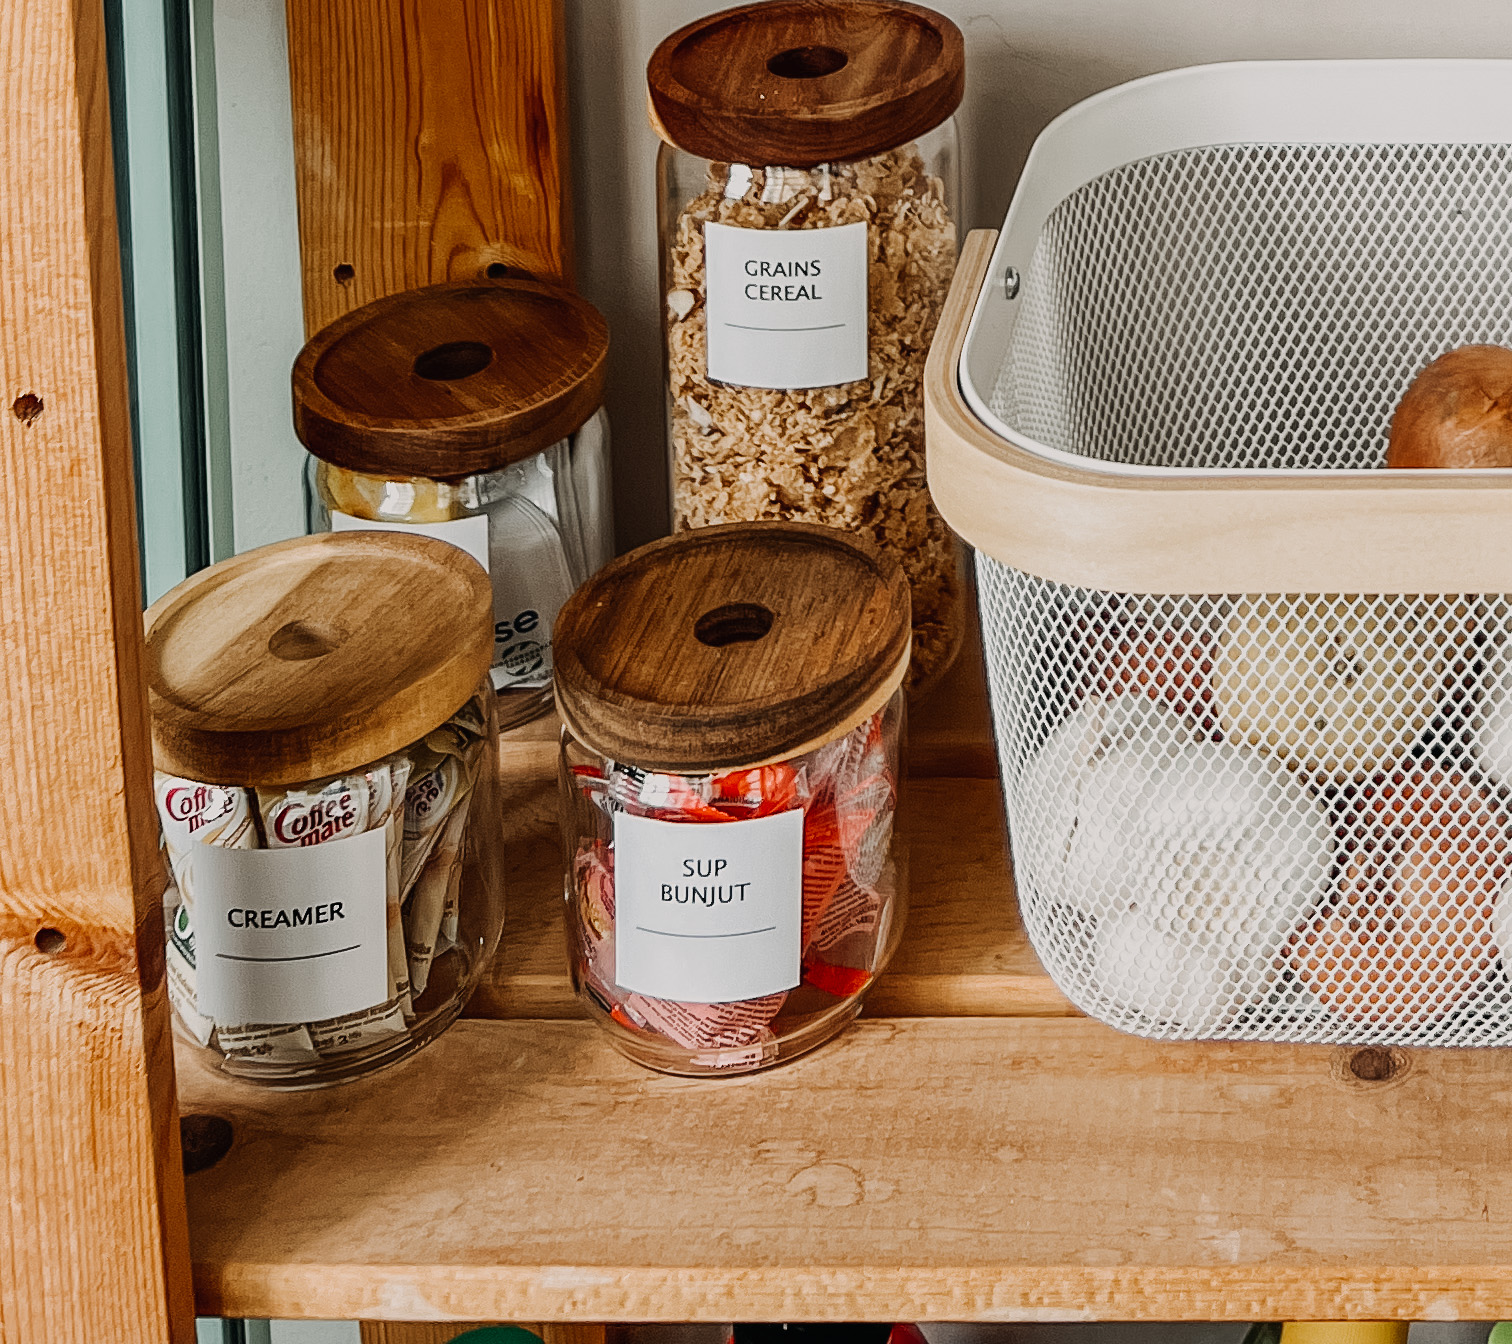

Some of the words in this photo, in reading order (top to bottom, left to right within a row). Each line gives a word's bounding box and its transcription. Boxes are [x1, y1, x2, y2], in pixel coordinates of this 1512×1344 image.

[744, 259, 822, 278] GRAINS
[744, 283, 823, 301] CEREAL
[274, 792, 352, 844] Coffee
[682, 858, 728, 878] SUP
[660, 882, 751, 907] BUNJUT
[227, 900, 346, 930] CREAMER
